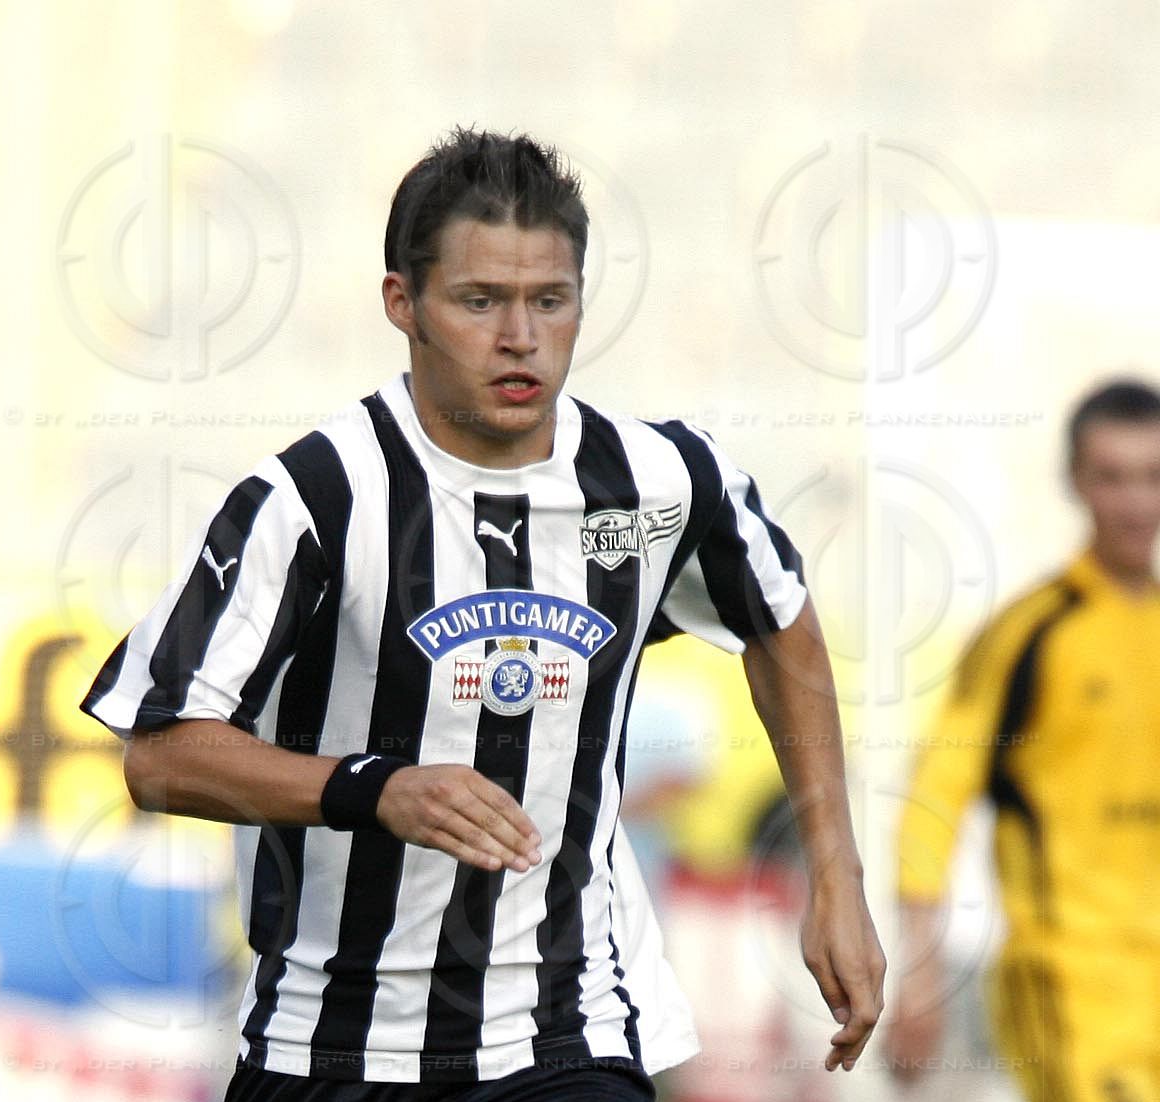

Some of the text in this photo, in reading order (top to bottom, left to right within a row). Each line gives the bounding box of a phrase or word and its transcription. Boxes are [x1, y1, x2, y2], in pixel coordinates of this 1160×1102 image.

[582, 527, 638, 553] SK STURM
[420, 601, 604, 651] PUNTIGAMER
